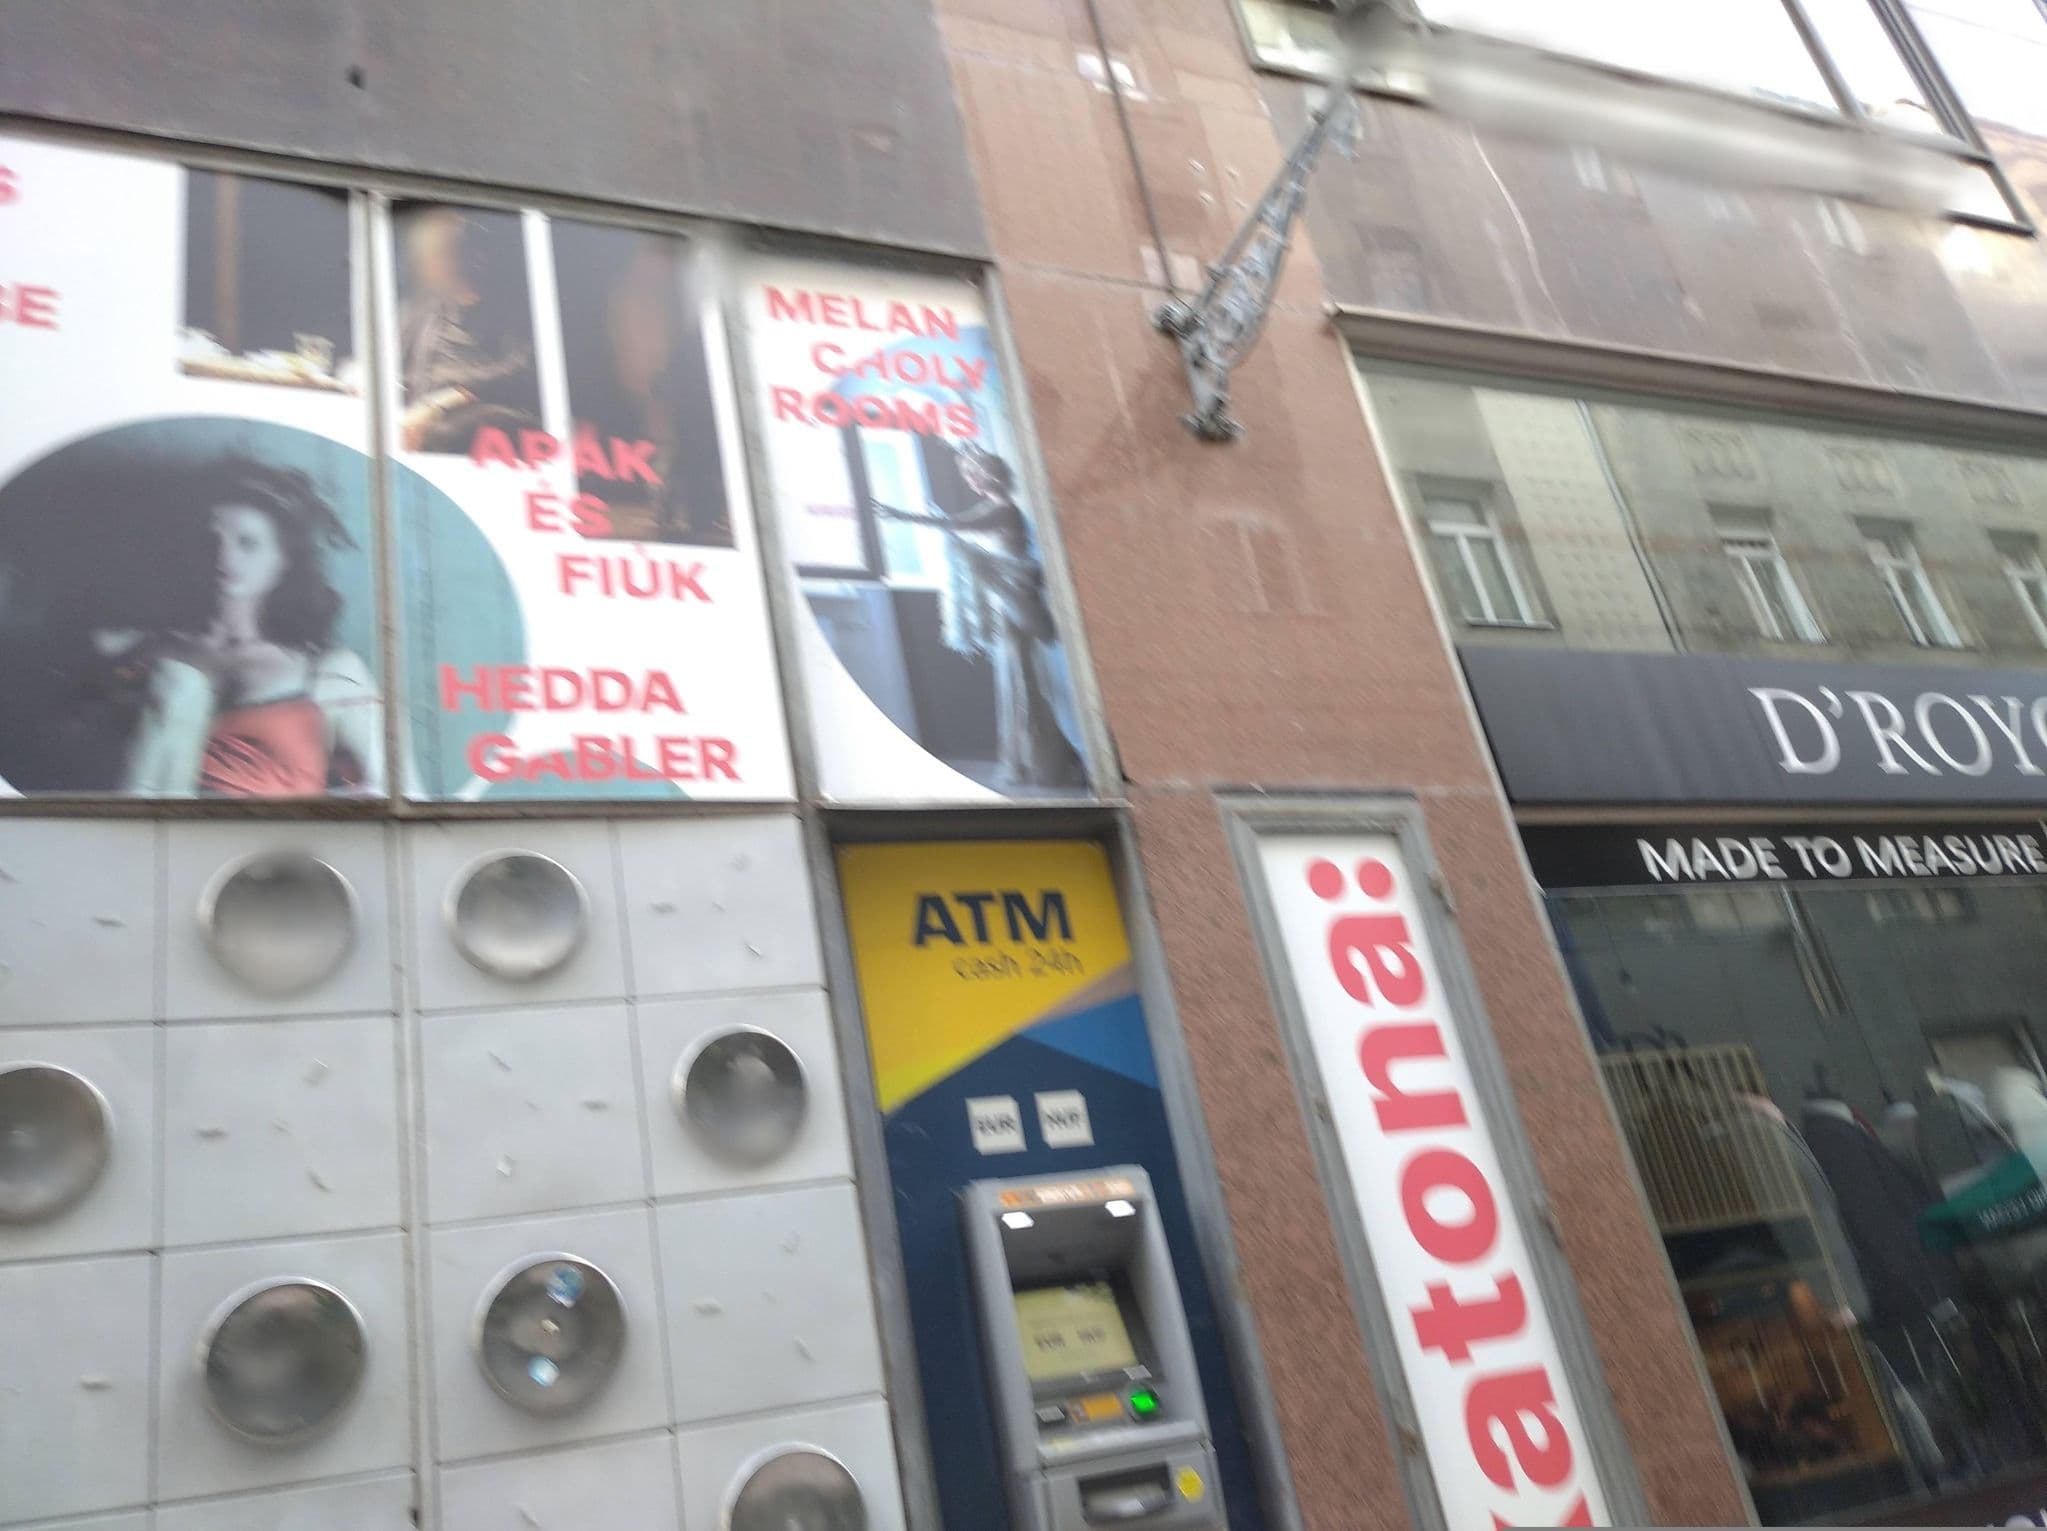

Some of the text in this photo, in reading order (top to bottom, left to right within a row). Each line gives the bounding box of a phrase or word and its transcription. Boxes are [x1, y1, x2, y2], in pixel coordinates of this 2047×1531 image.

[763, 285, 960, 341] MELAN
[811, 342, 989, 392] CHOLY
[772, 384, 980, 437] ROOMS
[469, 422, 662, 486] APÁK
[524, 478, 614, 539] ÉS
[555, 542, 714, 604] FIÚK
[439, 664, 687, 716] HEDDA
[467, 734, 744, 783] GABLER
[1637, 834, 2047, 882] MADE TO MEASURE
[912, 888, 1074, 946] ATM
[1029, 946, 1084, 977] 24h
